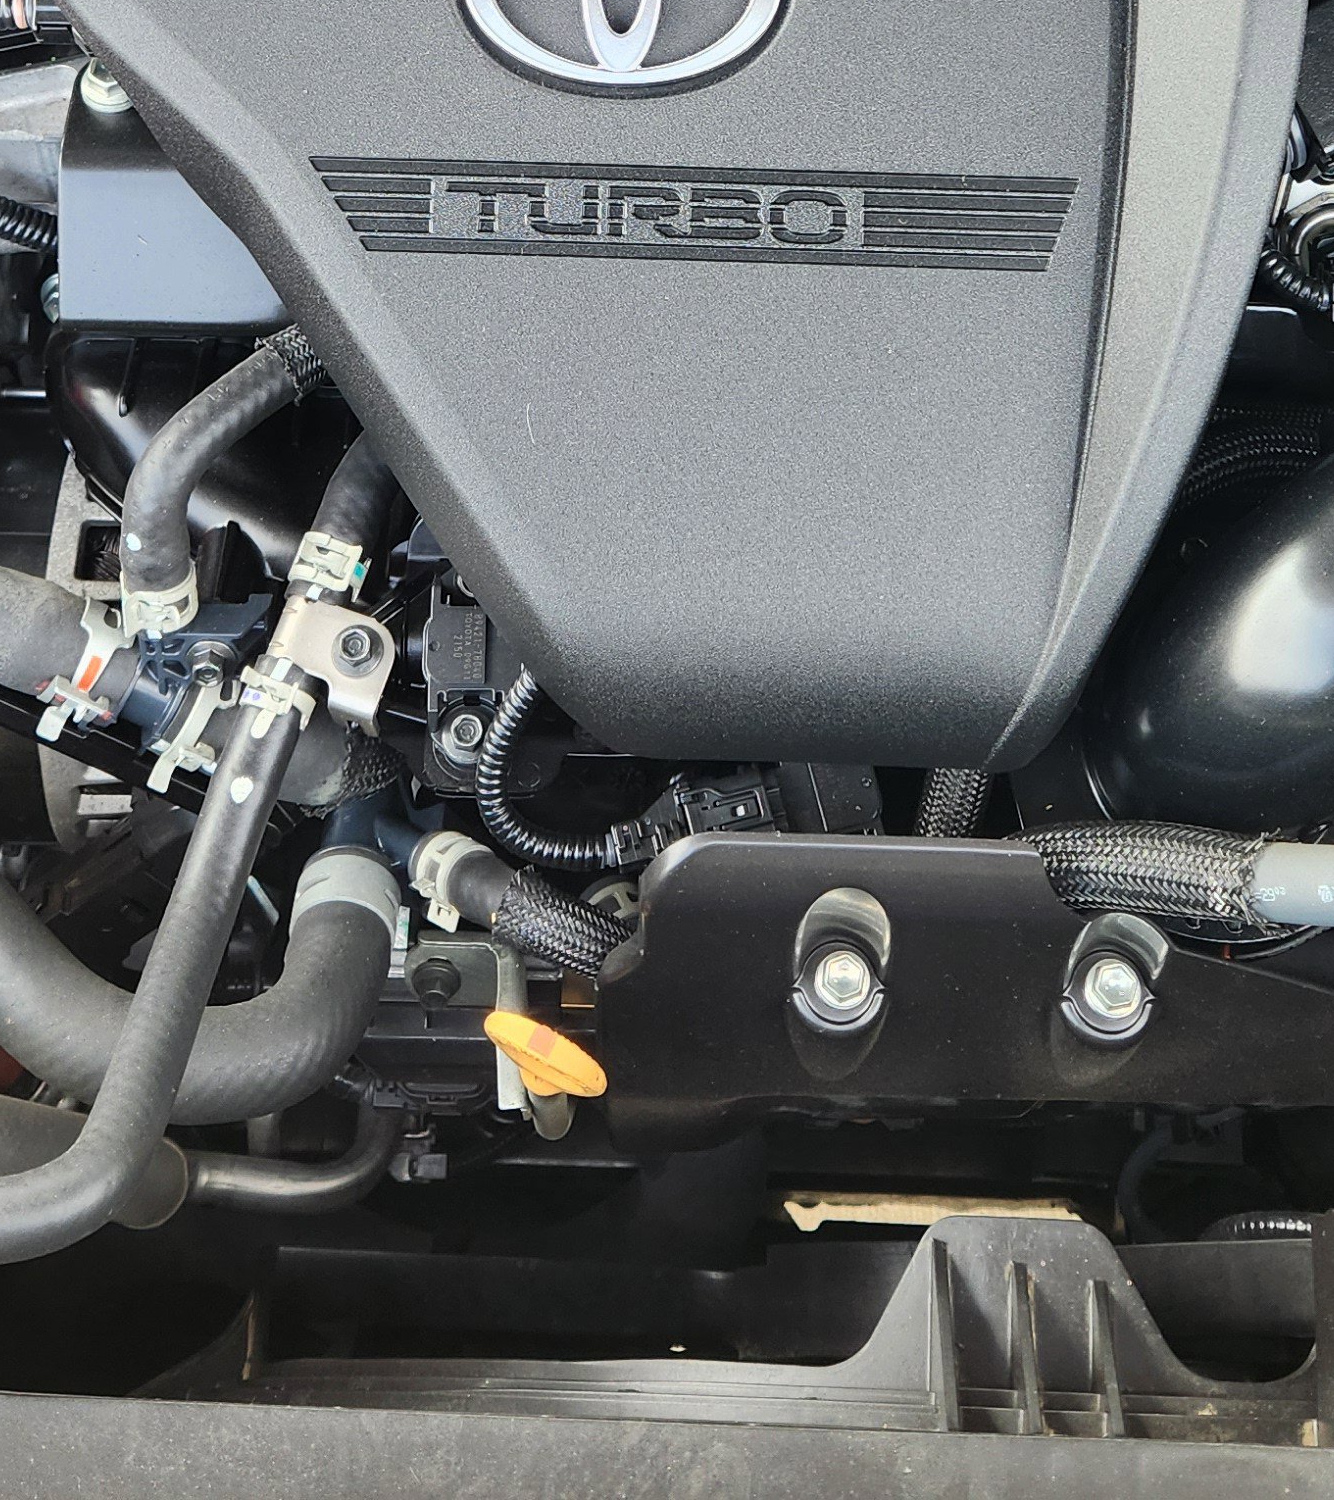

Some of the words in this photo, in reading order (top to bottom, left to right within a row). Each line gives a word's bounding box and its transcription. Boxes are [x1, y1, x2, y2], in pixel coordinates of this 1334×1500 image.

[445, 180, 848, 245] TURBO
[464, 612, 472, 645] TOYOTA
[453, 634, 462, 657] 2150
